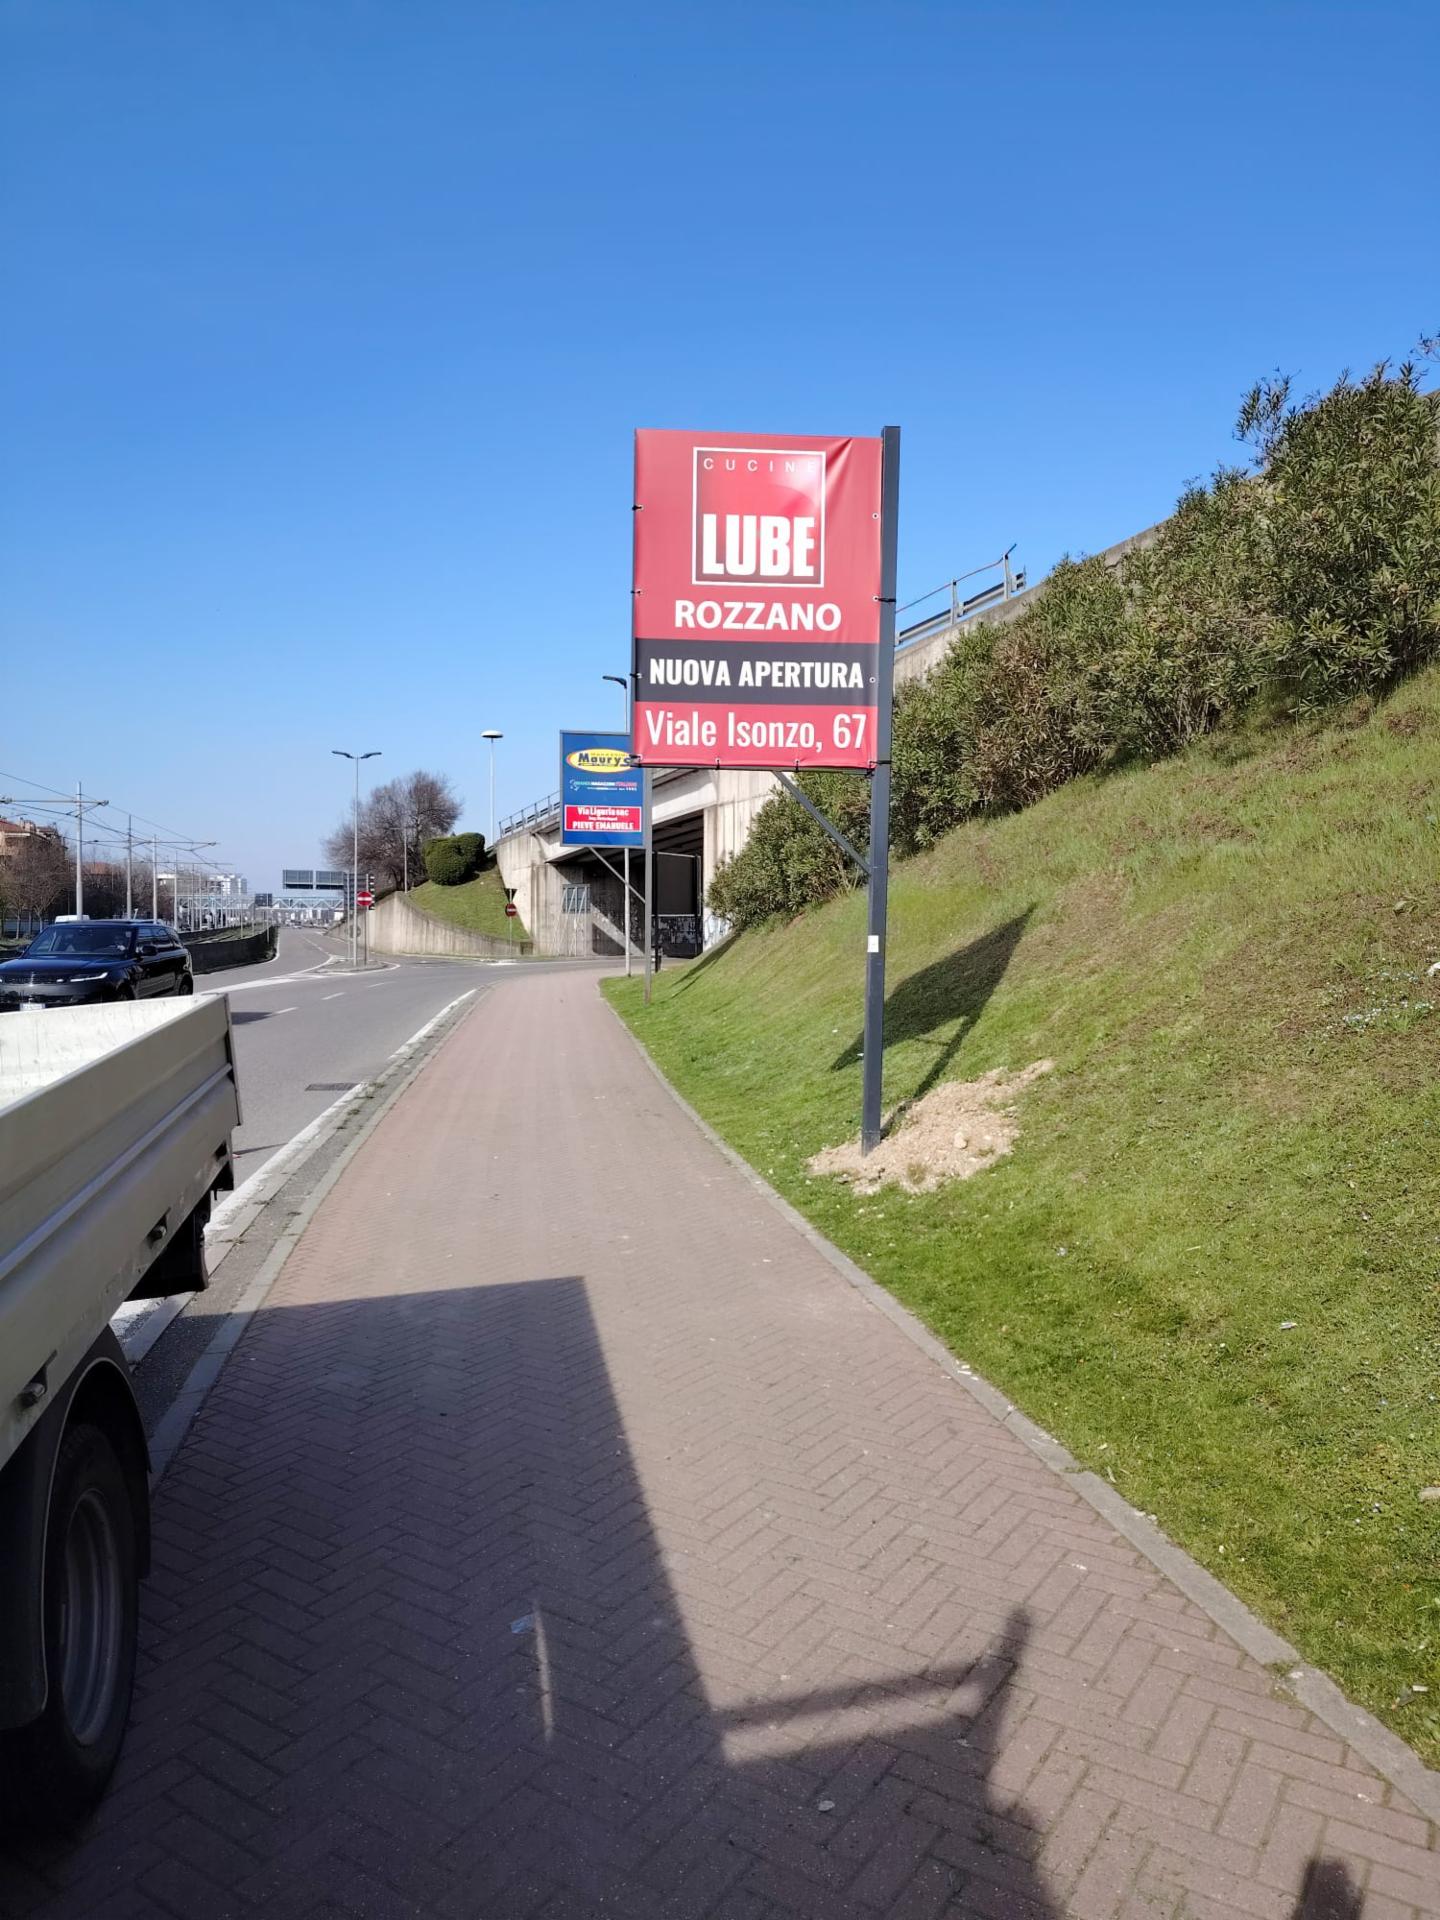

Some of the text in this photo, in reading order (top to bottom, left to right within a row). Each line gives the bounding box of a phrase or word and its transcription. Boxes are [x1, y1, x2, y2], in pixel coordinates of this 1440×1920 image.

[703, 457, 817, 474] CUCINE
[702, 513, 815, 577] LUBE
[674, 600, 841, 631] ROZZANO
[649, 658, 864, 688] NUOVA APERTURA
[646, 710, 867, 752] Viale Isonzo, 67
[573, 821, 634, 830] PIEVE EMANUELE
